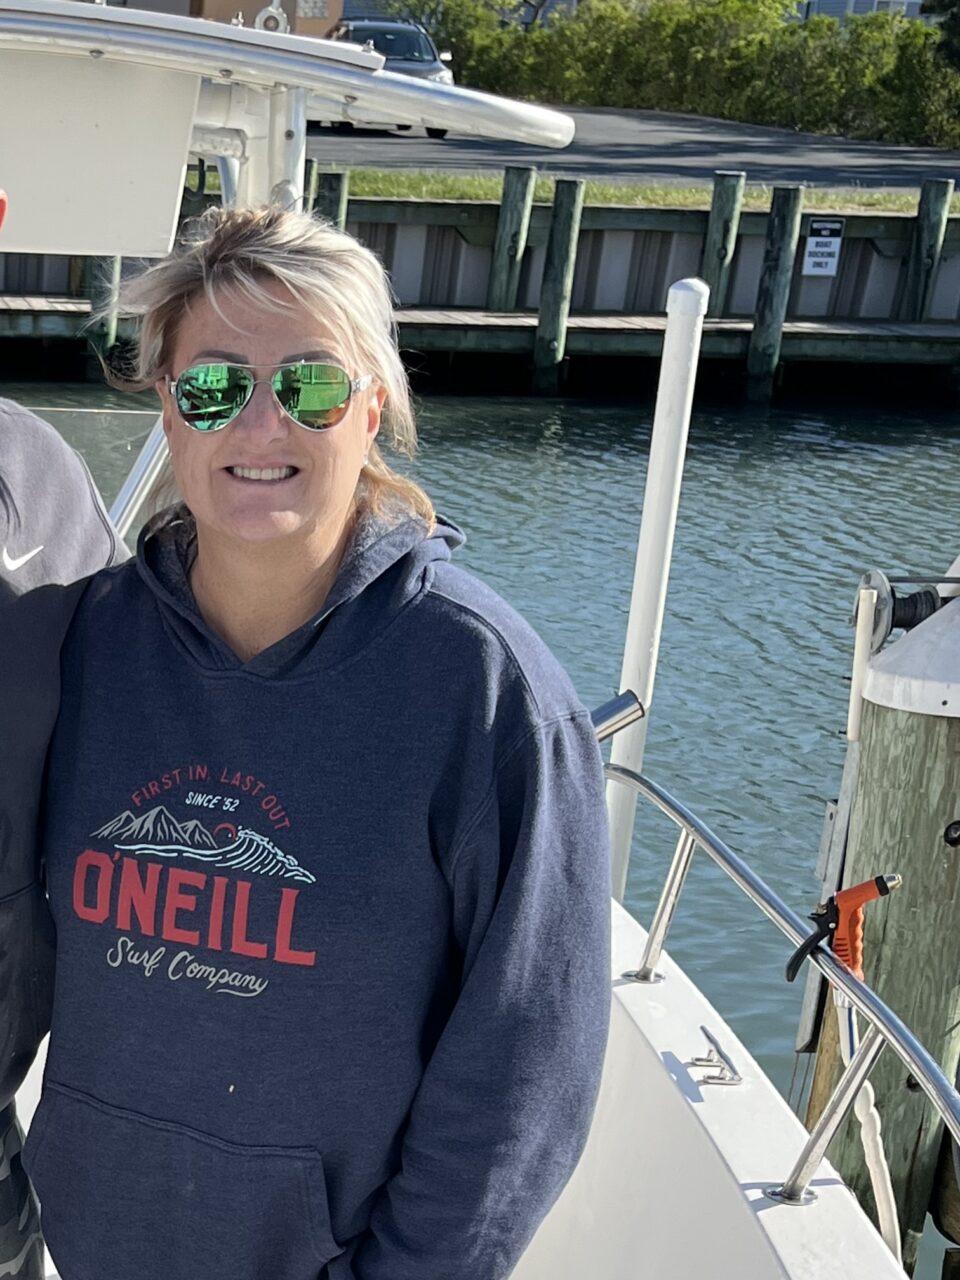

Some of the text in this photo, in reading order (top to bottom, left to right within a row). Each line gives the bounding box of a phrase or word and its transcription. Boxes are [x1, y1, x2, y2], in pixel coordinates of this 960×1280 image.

[131, 768, 182, 808] FIRST
[219, 767, 265, 797] LAST
[262, 794, 291, 831] OUT
[185, 791, 220, 810] SINCE
[73, 849, 316, 966] O'NEILL
[106, 936, 270, 998] Surf Company
